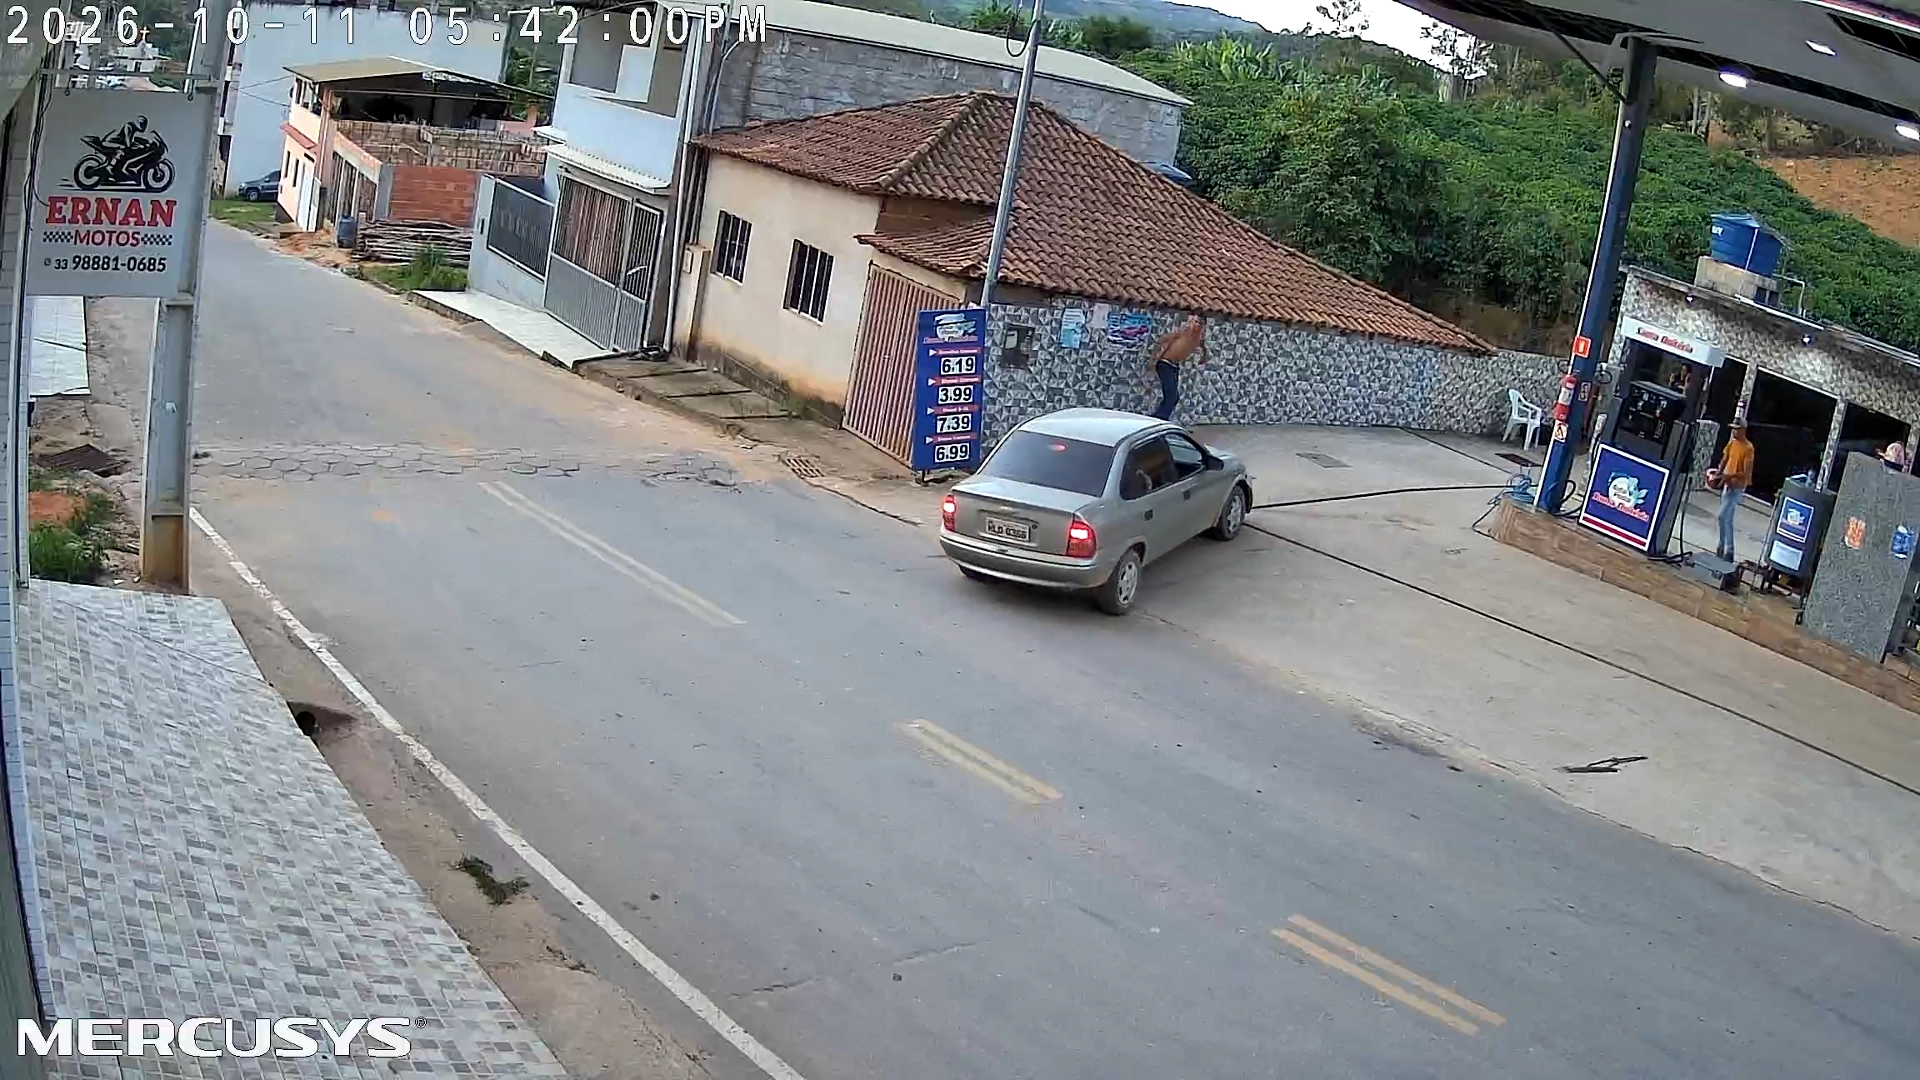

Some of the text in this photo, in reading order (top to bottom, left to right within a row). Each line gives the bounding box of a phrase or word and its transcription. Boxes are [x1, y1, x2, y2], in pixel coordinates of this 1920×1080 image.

[45, 196, 178, 227] ERNAN
[73, 230, 141, 247] MOTOS
[54, 255, 167, 272] 33 98881-0685
